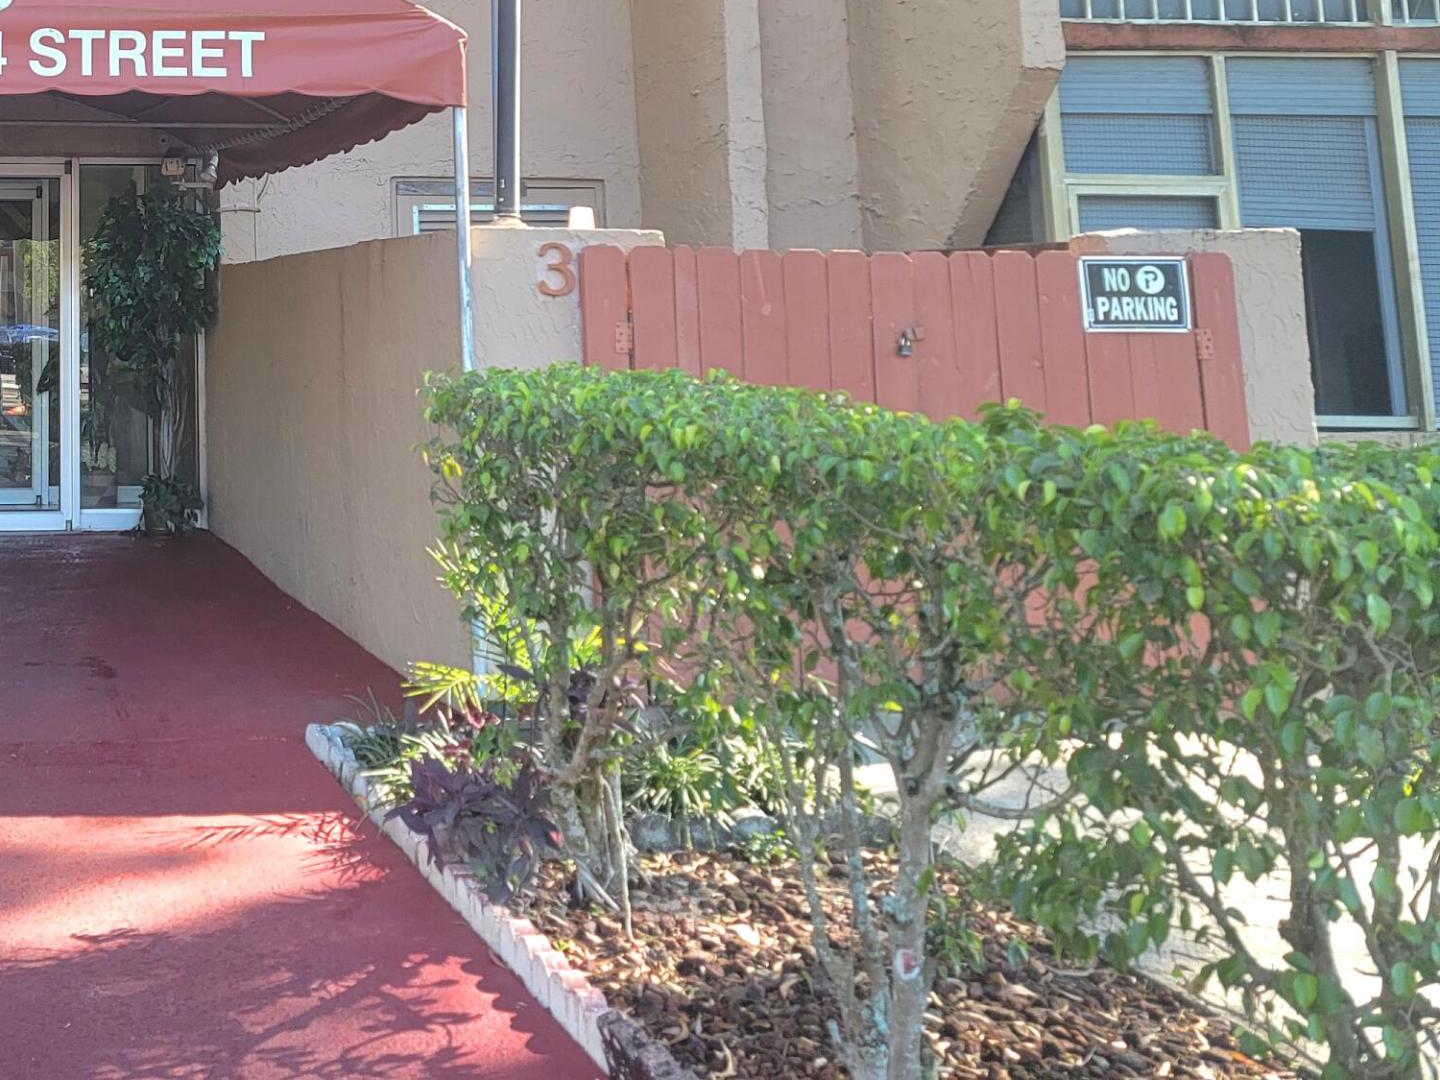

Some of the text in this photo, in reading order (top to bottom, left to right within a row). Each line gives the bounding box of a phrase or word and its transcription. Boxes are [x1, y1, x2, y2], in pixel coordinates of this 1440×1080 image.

[28, 27, 265, 78] STREET
[537, 241, 576, 297] 3
[1103, 267, 1131, 292] NO
[1096, 296, 1179, 322] PARKING
